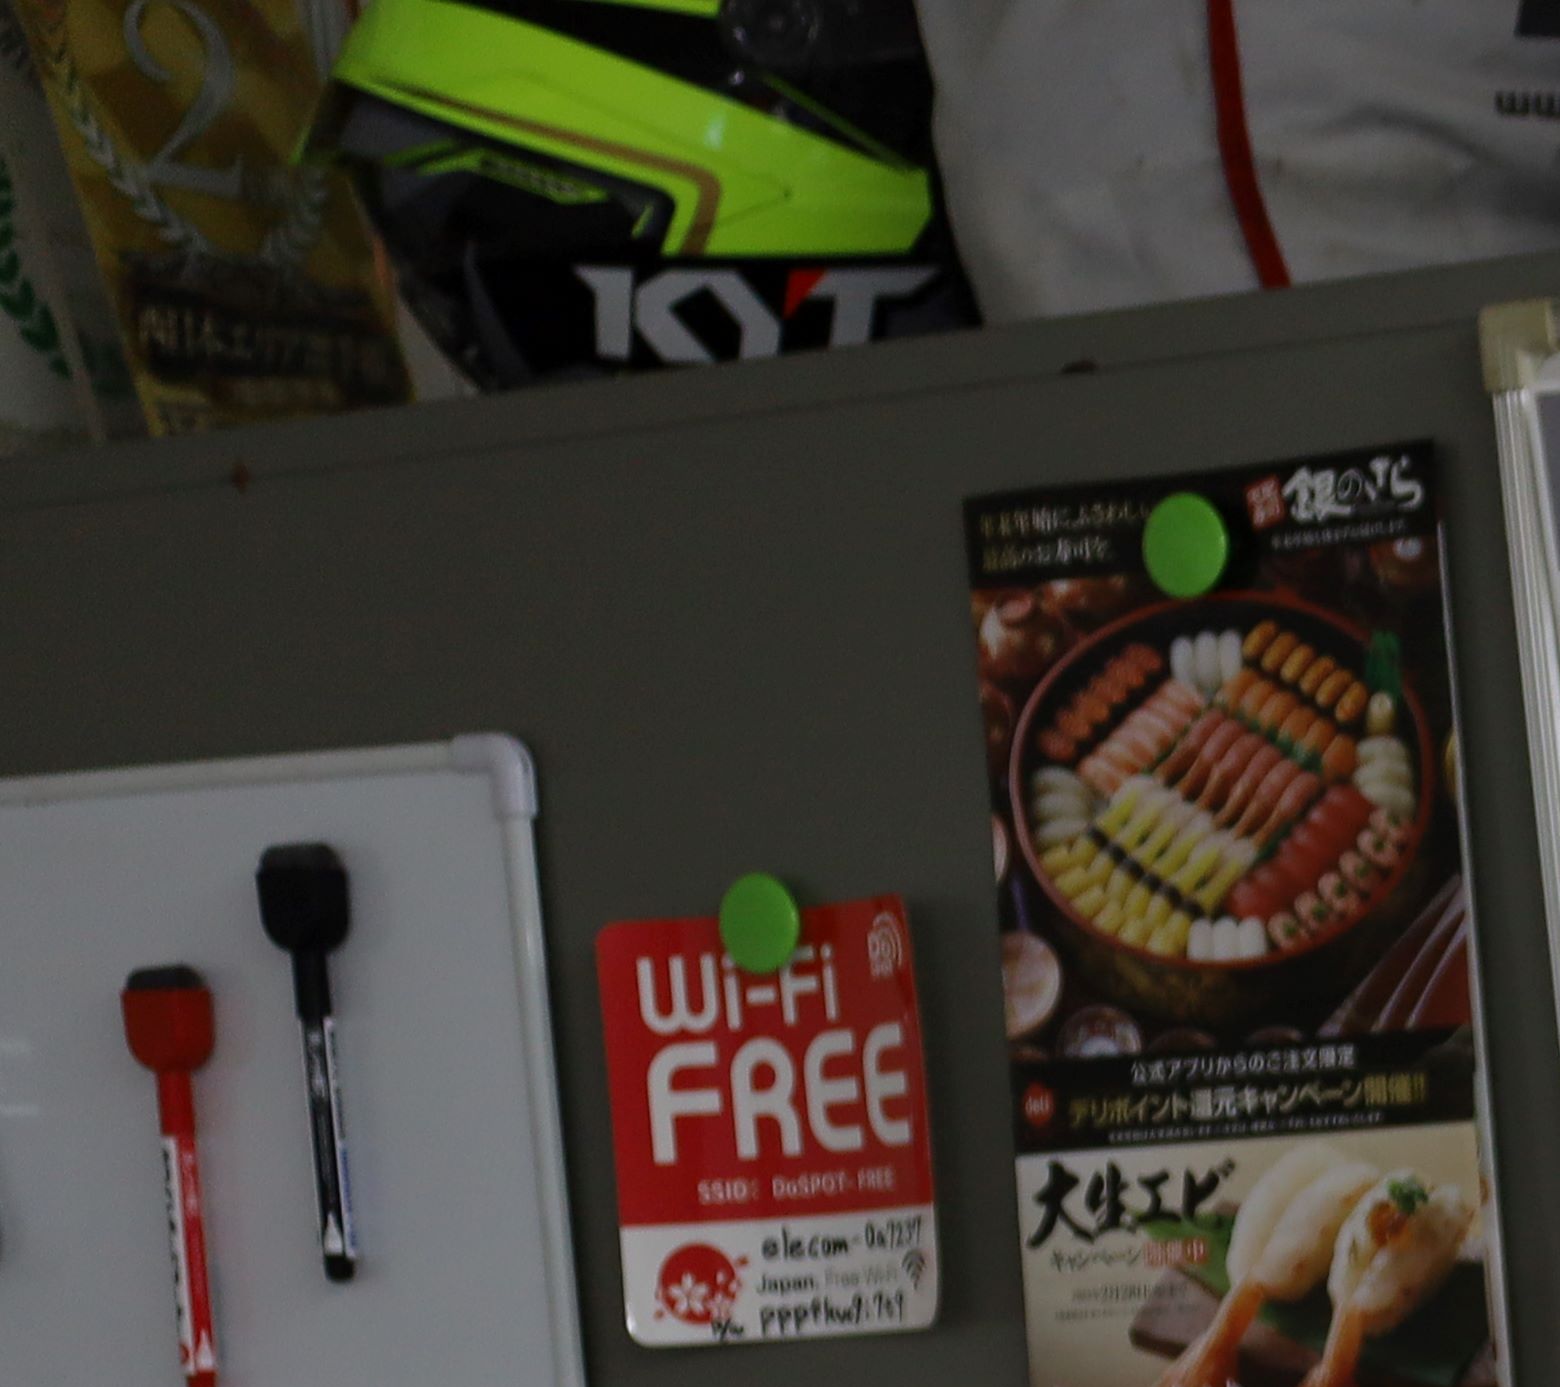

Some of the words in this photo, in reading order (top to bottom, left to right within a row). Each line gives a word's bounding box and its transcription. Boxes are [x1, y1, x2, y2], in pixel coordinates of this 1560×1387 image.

[574, 264, 941, 366] KYT
[636, 945, 839, 1034] Wi-Fi
[645, 1022, 913, 1166] FREE
